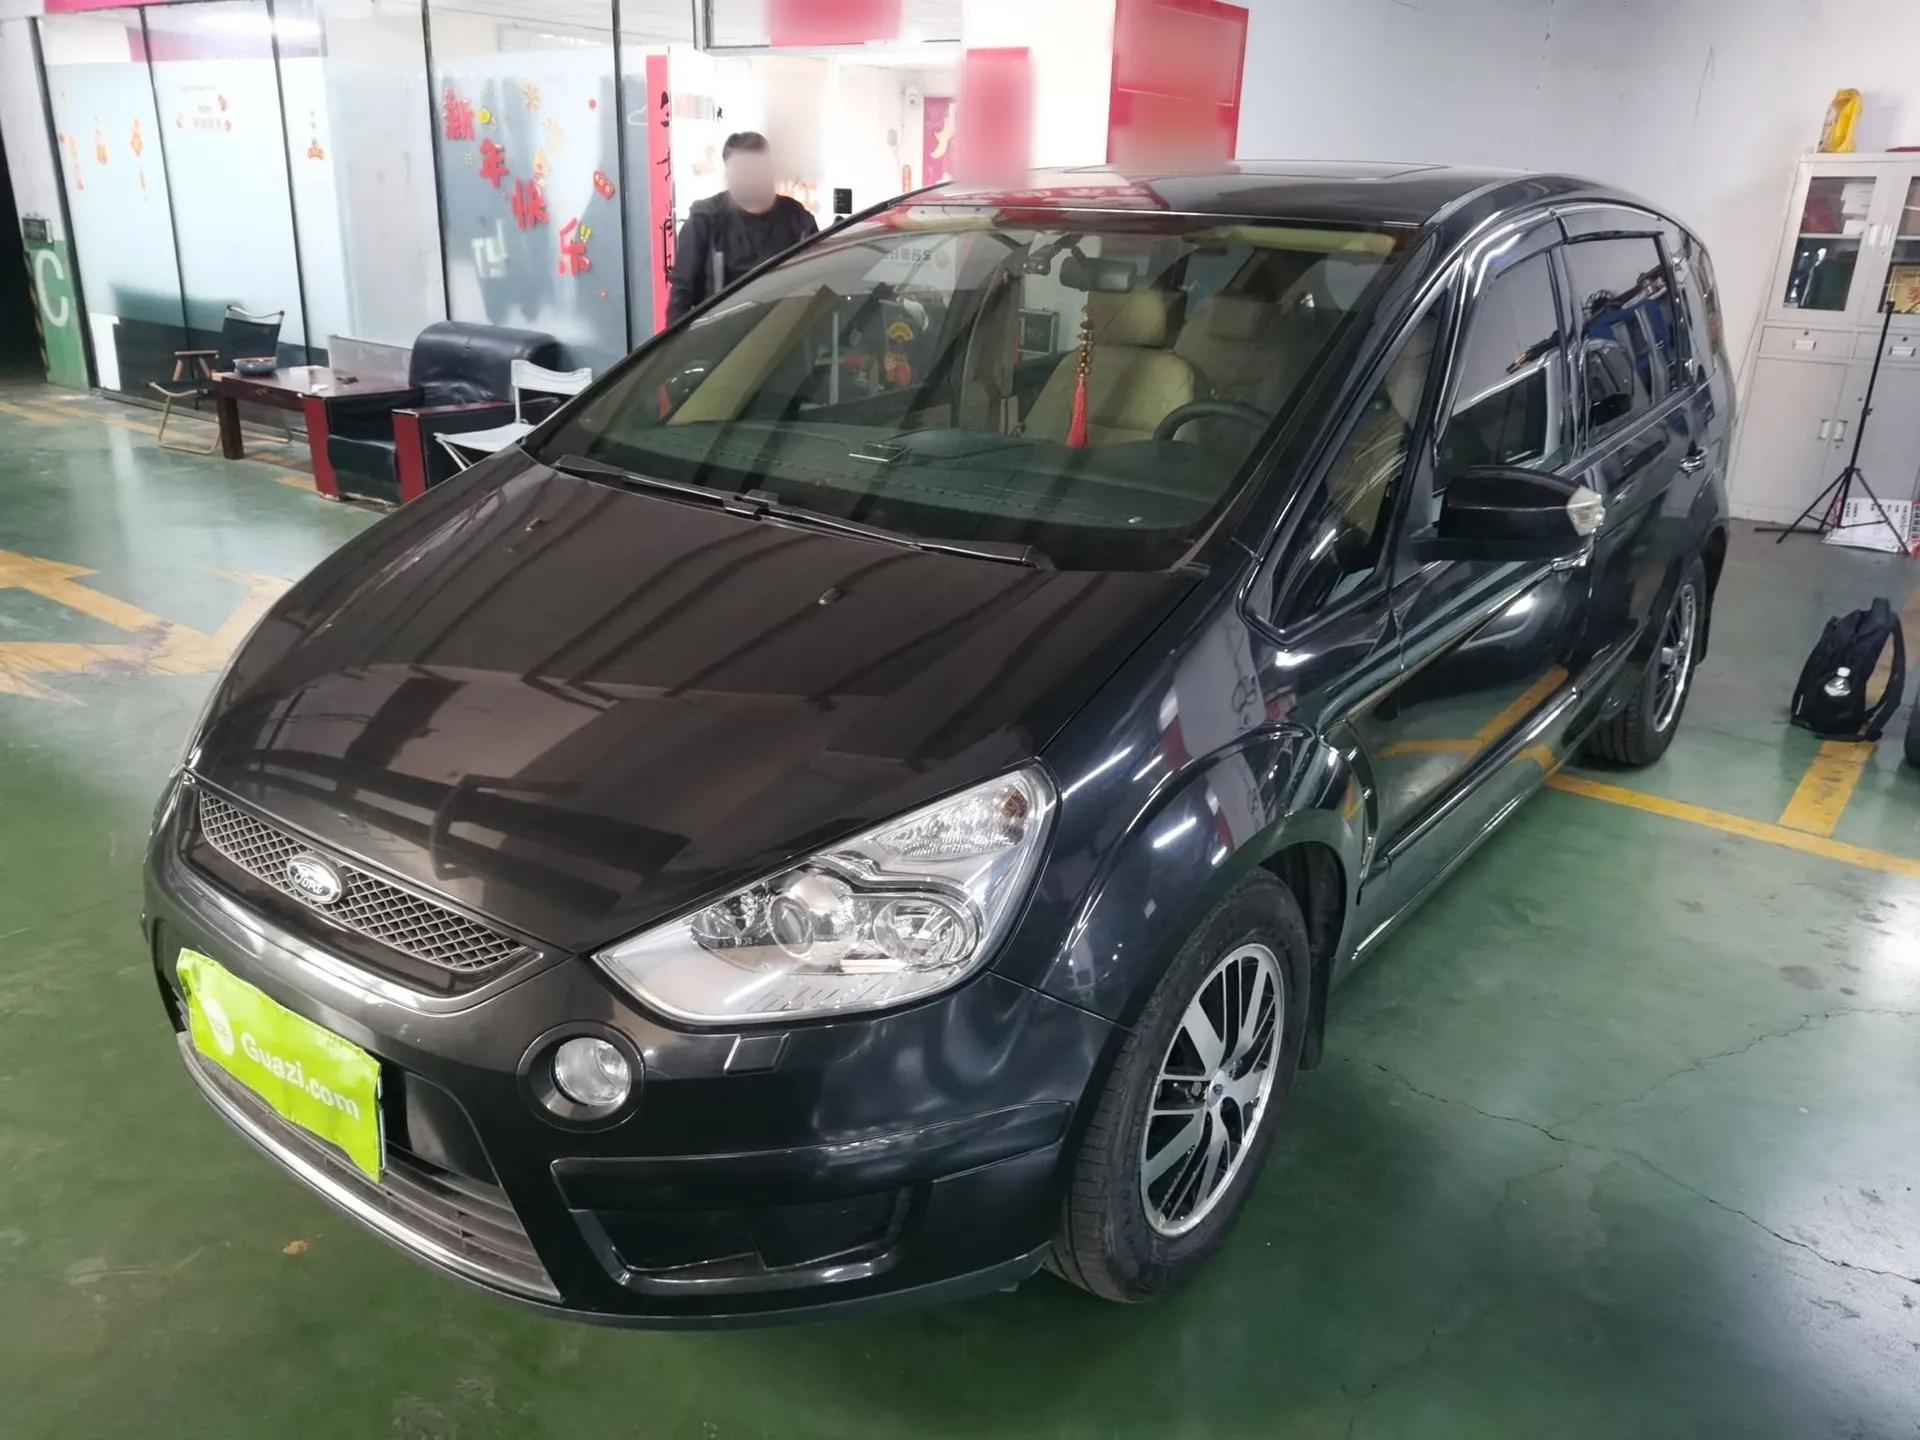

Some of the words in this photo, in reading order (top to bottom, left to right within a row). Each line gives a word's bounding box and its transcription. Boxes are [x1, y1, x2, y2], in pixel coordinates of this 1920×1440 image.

[35, 249, 69, 327] C
[293, 865, 328, 895] Ford
[240, 1031, 360, 1121] Guazi.com
